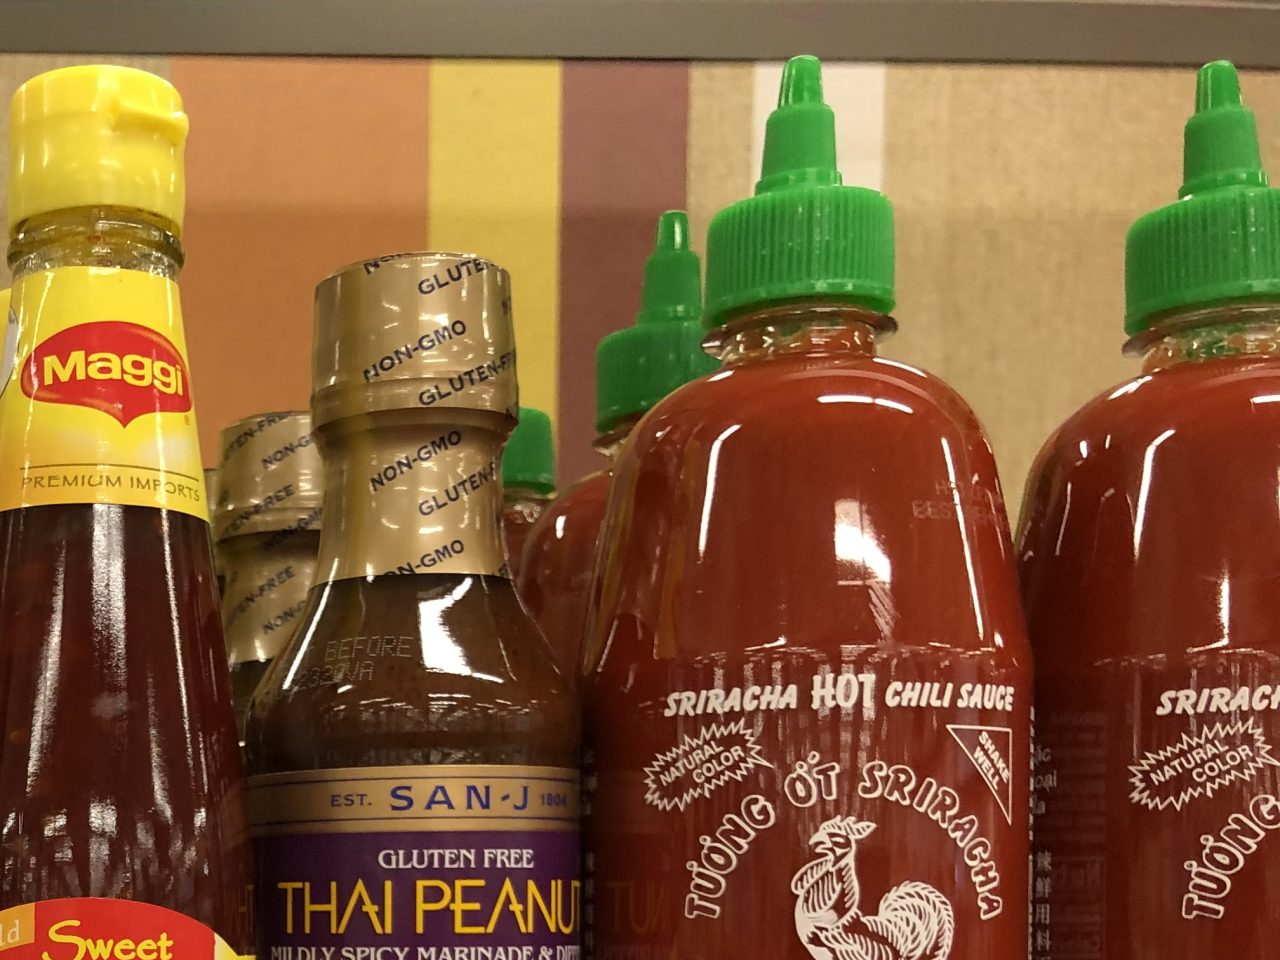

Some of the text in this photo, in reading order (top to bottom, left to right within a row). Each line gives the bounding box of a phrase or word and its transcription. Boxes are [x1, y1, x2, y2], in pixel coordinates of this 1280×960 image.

[43, 350, 184, 397] Maggi
[363, 320, 467, 383] NON-GMO
[21, 473, 122, 490] PREMIUM
[371, 429, 462, 493] NON-GMO
[664, 673, 1013, 717] SRIRACHA HOT CHILI SAUCE
[659, 740, 723, 787] NATURAL
[692, 745, 746, 784] COLOR
[1149, 740, 1229, 786] NATURAL
[1192, 744, 1253, 783] COLOR
[330, 793, 372, 807] EST.
[378, 849, 534, 870] GLUTEN FREE
[858, 760, 1002, 922] SRIRACHA
[277, 877, 393, 934] THAI
